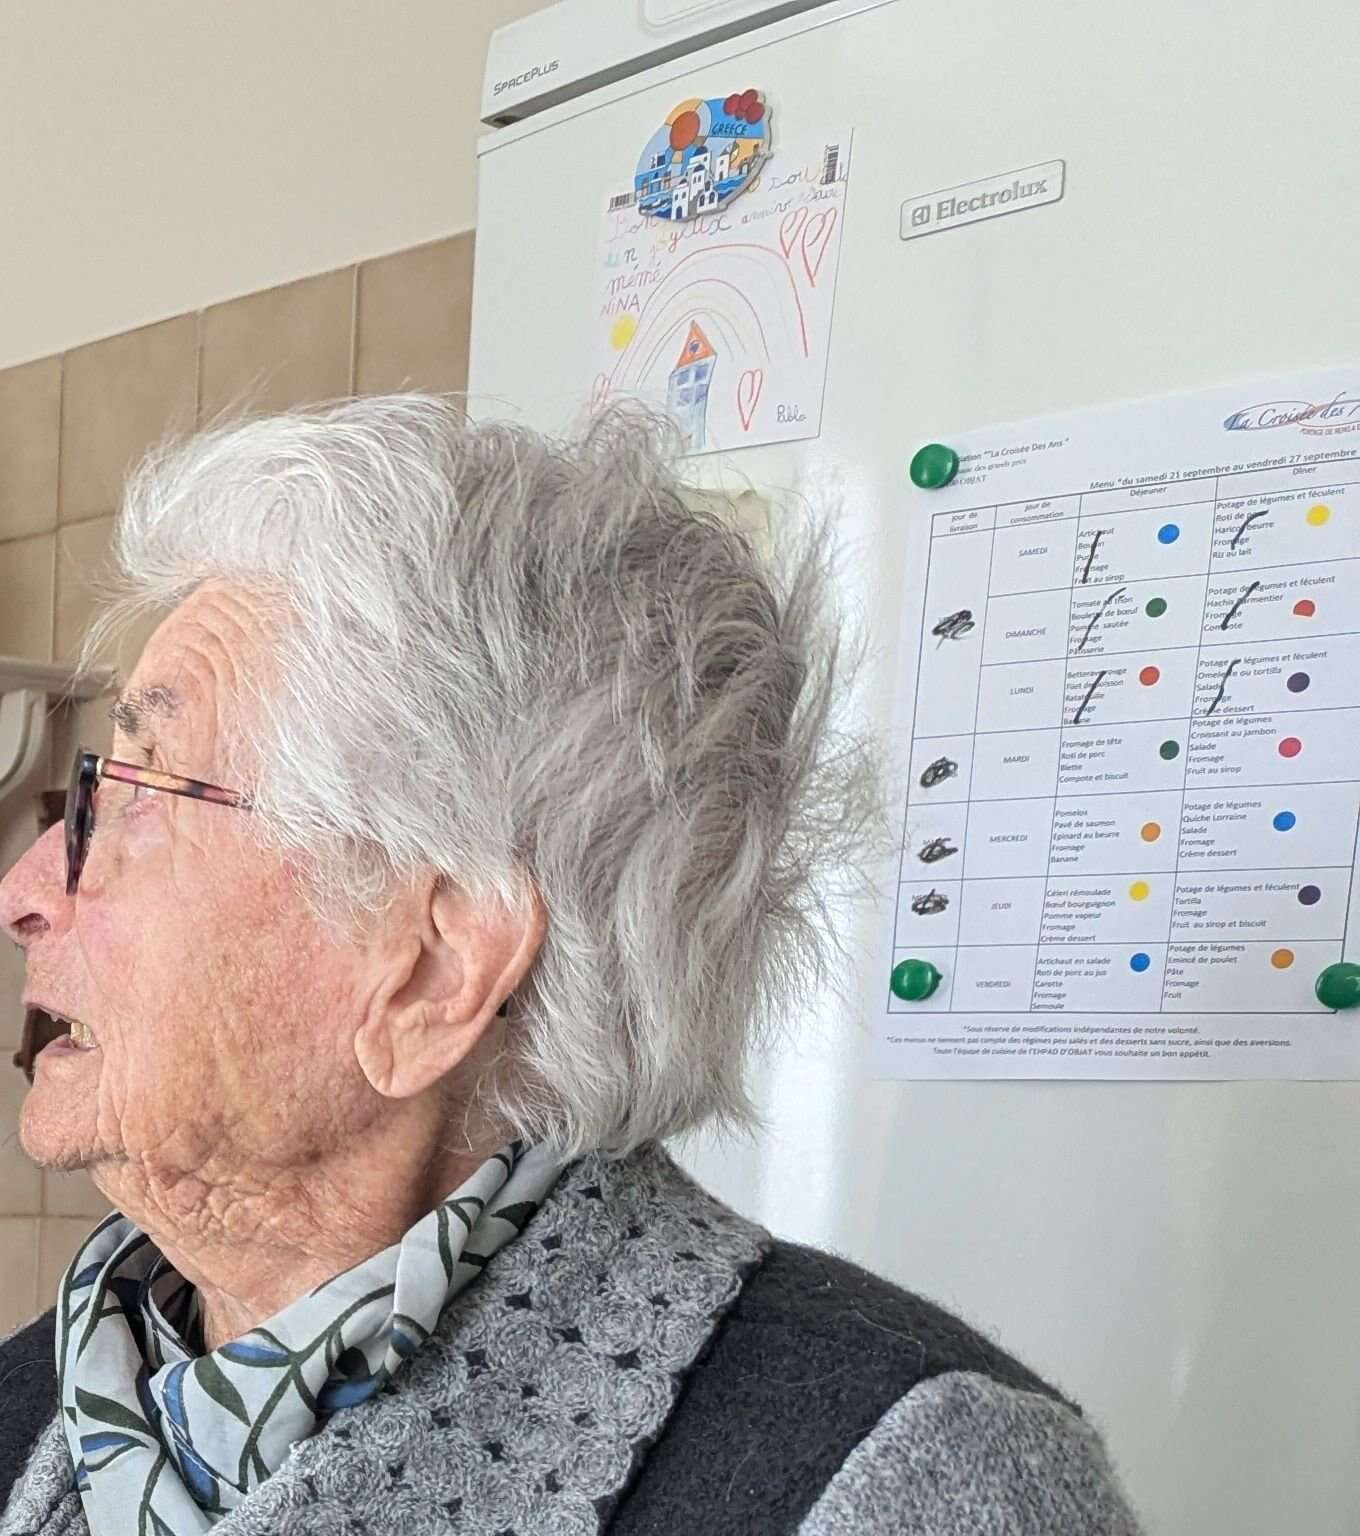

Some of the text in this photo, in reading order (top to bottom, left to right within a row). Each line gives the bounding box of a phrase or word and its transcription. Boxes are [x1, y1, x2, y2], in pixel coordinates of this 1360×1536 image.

[711, 123, 748, 136] GREECE
[936, 179, 1049, 221] Electrolux
[1320, 391, 1346, 420] des
[1032, 443, 1046, 451] Des
[1089, 448, 1357, 490] Menu samedi 21 septembre au vendredi 27 septembre
[1130, 486, 1167, 497] Déjeuner
[1217, 500, 1244, 510] Potage
[1260, 495, 1295, 505] légumes
[1297, 492, 1306, 500] et
[1308, 488, 1345, 498] féculent
[1018, 547, 1048, 556] SAMEDI
[1239, 548, 1252, 556] lait
[1208, 587, 1237, 595] Potage
[1300, 576, 1335, 586] féculent
[1105, 609, 1115, 617] de
[1005, 628, 1046, 639] DIMANCHE
[1244, 655, 1280, 665] légumes
[1293, 651, 1328, 660] féculent
[1254, 667, 1282, 675] tortilla
[1010, 687, 1034, 695] LUNDI
[1223, 705, 1254, 713] dessert
[1236, 716, 1272, 725] légumes
[1191, 731, 1229, 739] Croissant
[1243, 728, 1276, 737] jambon
[1062, 740, 1093, 749] Fromage
[1190, 743, 1216, 751] Salade
[1003, 755, 1030, 763] MARDI
[1089, 751, 1105, 760] porc
[1189, 755, 1224, 763] Fromage
[1220, 766, 1242, 774] sirop
[1058, 774, 1093, 783] Compote
[1184, 803, 1211, 811] Potage
[1226, 801, 1262, 810] légumes
[1183, 813, 1247, 822] Quiche Lorraine
[1074, 820, 1083, 828] de
[1182, 826, 1207, 834] Salade
[989, 834, 1028, 843] MERCREDI
[1095, 831, 1120, 839] beurre
[1052, 844, 1085, 852] Fromage
[1180, 848, 1237, 858] Crème dessert
[1050, 855, 1079, 863] Banane
[1176, 886, 1202, 894] Potage
[1217, 884, 1251, 893] légumes
[1042, 924, 1075, 932] Fromage
[1206, 920, 1226, 928] sirop
[1040, 934, 1096, 942] Crème dessert
[1169, 944, 1245, 952] Potage de légumes
[1038, 957, 1073, 965] Artichaut
[1086, 957, 1111, 965] salade
[1035, 980, 1063, 988] Carotte
[1165, 980, 1199, 988] Fromage
[1034, 991, 1067, 999] Fromage
[1031, 1002, 1064, 1010] Semoule
